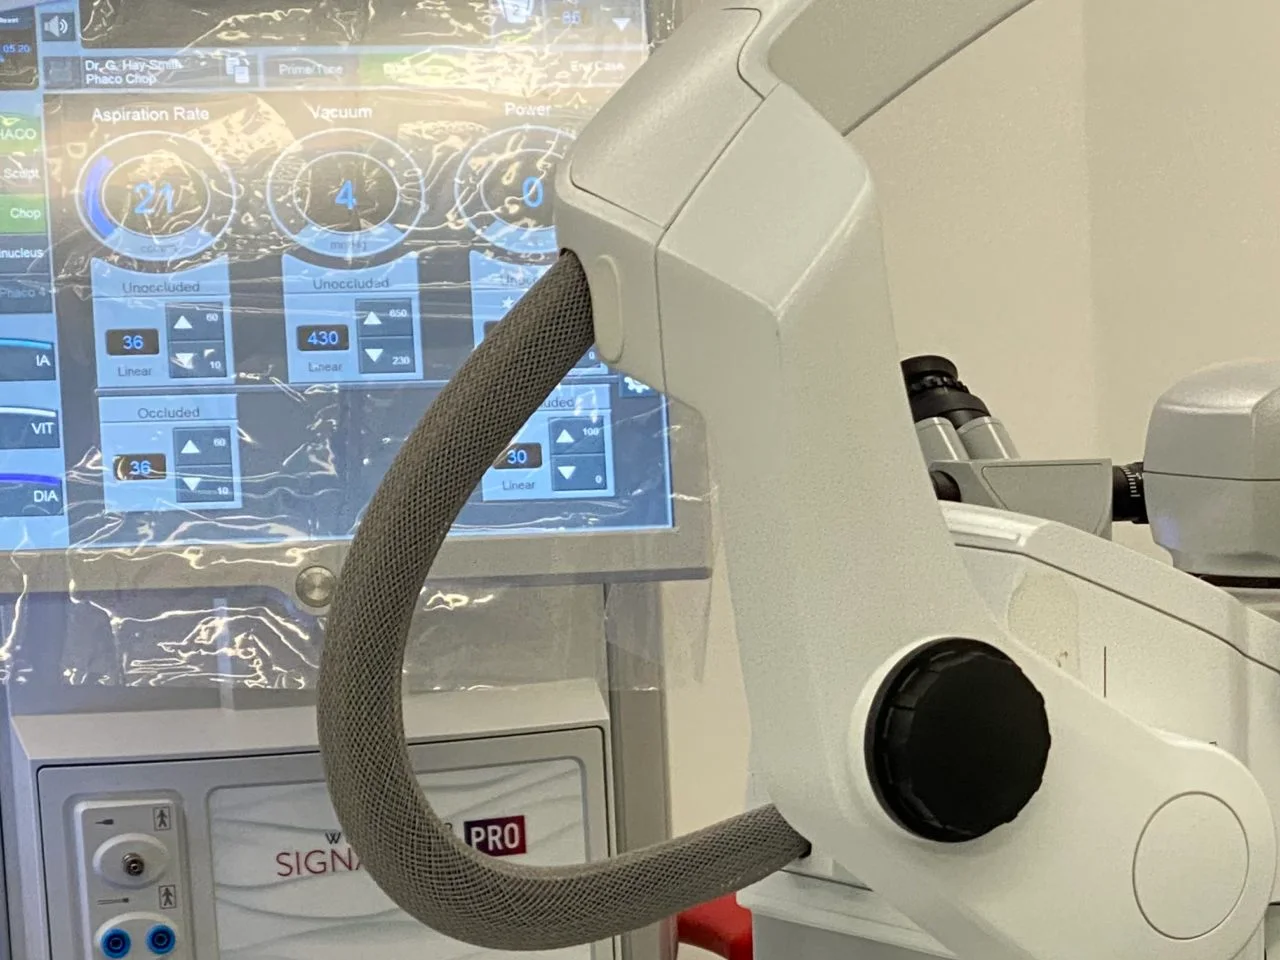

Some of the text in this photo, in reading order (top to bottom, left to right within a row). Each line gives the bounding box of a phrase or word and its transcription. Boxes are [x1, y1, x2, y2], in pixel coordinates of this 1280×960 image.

[86, 73, 157, 86] Phaco Chop
[92, 107, 209, 124] Aspiration Rate
[311, 106, 372, 119] Vacuum
[504, 102, 551, 116] Power
[132, 182, 175, 215] 21
[334, 180, 357, 209] 4
[522, 177, 545, 208] 0
[10, 208, 41, 220] Chop
[122, 281, 200, 294] Unoccluded
[313, 278, 390, 290] Unoccluded
[123, 335, 144, 350] 36
[307, 330, 339, 345] 430
[36, 354, 51, 367] IA
[210, 361, 221, 369] 10
[308, 361, 343, 372] Linear
[392, 356, 410, 365] 230
[117, 366, 152, 377] Linear
[137, 407, 200, 419] Occluded
[31, 422, 54, 435] VIT
[583, 427, 600, 436] 100
[506, 449, 527, 464] 30
[129, 460, 151, 475] 36
[502, 480, 536, 490] Linear
[595, 475, 603, 484] 0
[33, 490, 58, 503] DIA
[217, 486, 229, 495] 10
[470, 822, 521, 852] PRO
[275, 847, 362, 877] SIGN
